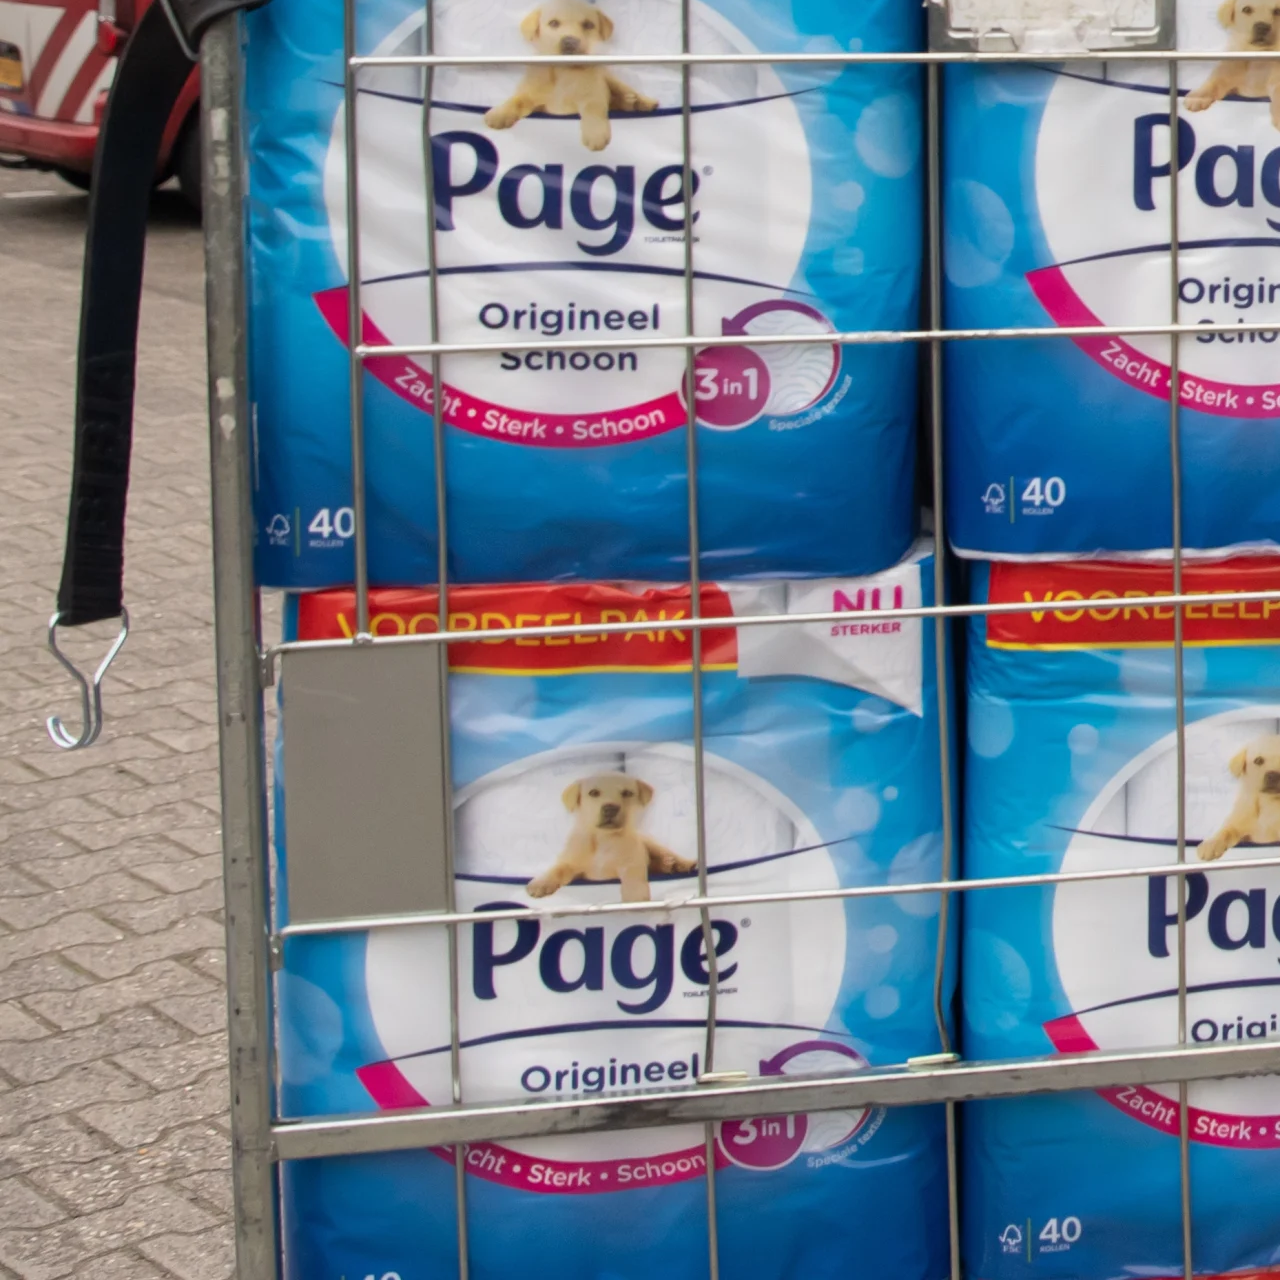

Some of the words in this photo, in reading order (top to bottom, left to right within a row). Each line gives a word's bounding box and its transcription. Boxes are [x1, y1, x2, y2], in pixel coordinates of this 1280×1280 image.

[478, 302, 660, 336] Origineel
[499, 349, 637, 372] Schoon
[1100, 341, 1162, 389] Zacht
[1180, 379, 1239, 410] Sterk
[768, 410, 822, 431] Speciale
[822, 373, 853, 414] textuur
[480, 408, 547, 440] Sterk
[571, 405, 666, 441] Schoon
[1022, 476, 1066, 507] 40
[308, 506, 356, 538] 40
[832, 586, 903, 612] NU
[829, 622, 902, 637] STERKER
[520, 1051, 700, 1094] Origineel
[1114, 1084, 1177, 1127] Zacht
[1193, 1115, 1253, 1141] Sterk
[526, 1163, 592, 1188] Sterk
[616, 1151, 706, 1185] Schoon
[807, 1143, 858, 1168] Speciale
[1039, 1216, 1081, 1243] 40
